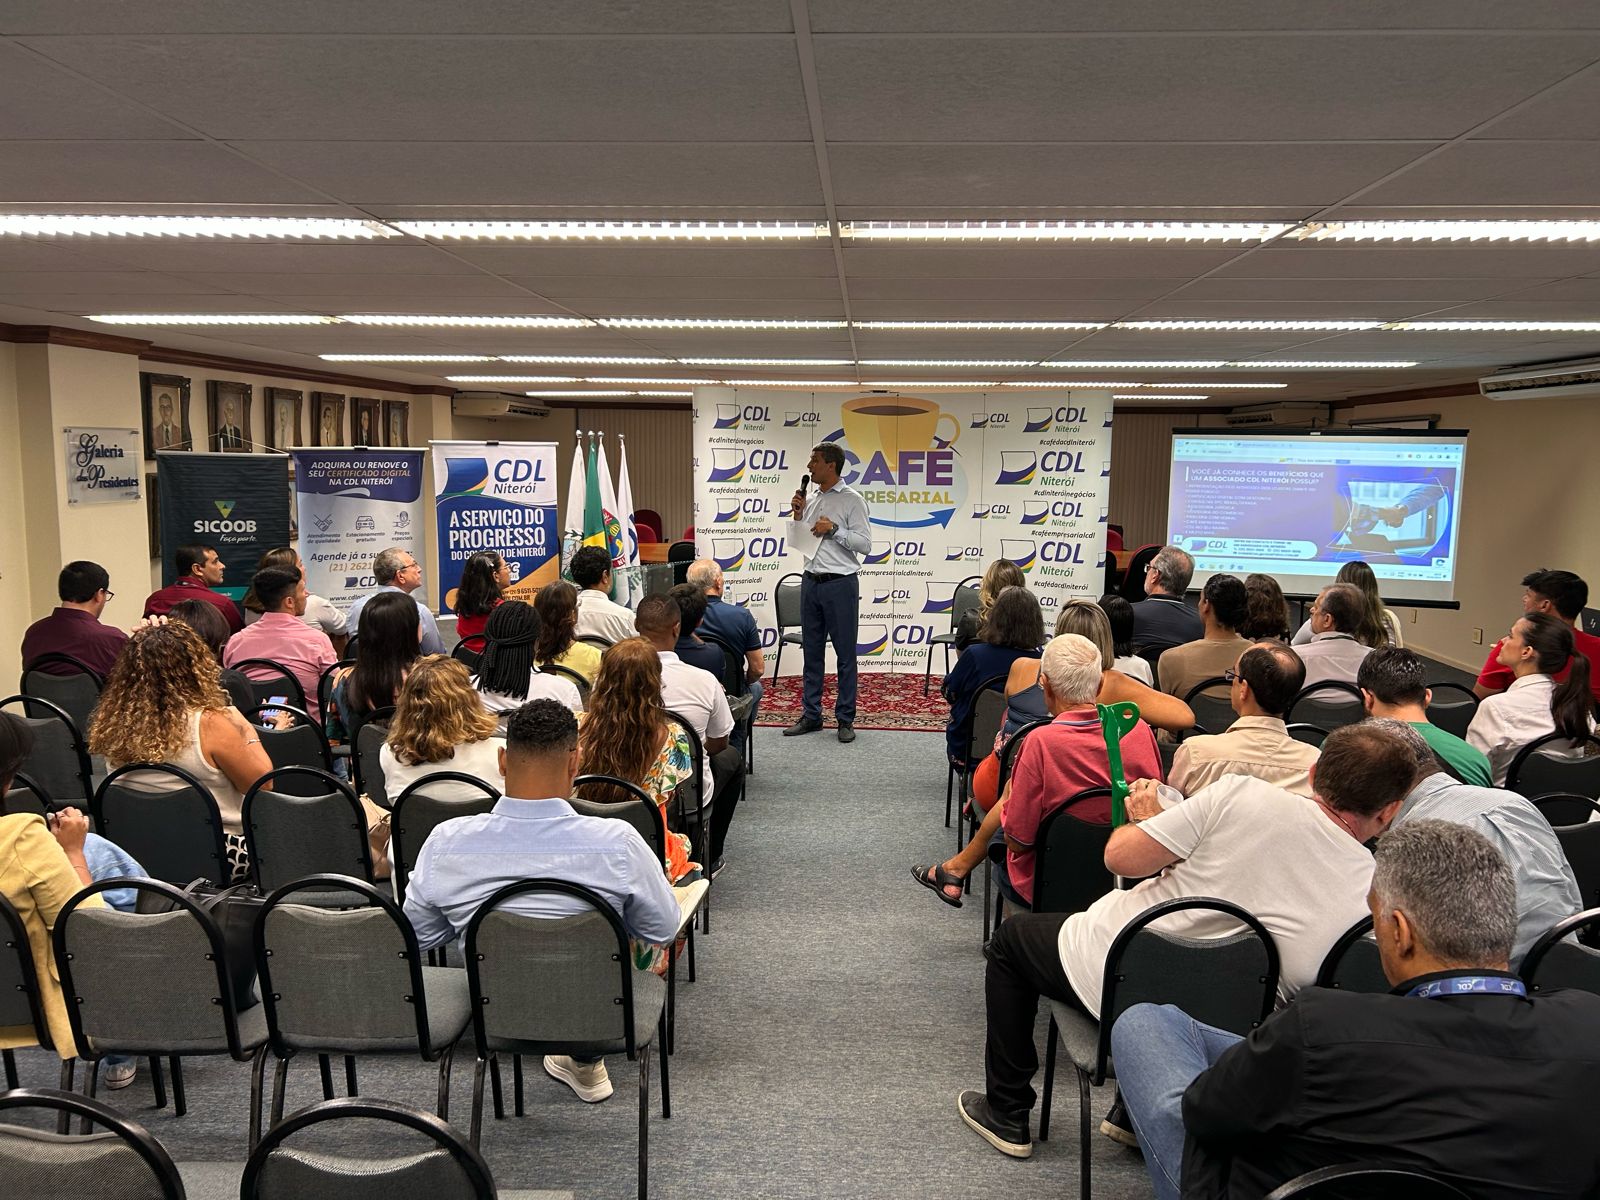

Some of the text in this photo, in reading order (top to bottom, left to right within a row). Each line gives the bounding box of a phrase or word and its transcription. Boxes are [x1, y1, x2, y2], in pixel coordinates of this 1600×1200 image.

[743, 405, 771, 421] CDL
[802, 412, 821, 422] CDL
[990, 413, 1010, 423] CDL
[1055, 407, 1088, 423] CDL
[743, 423, 766, 431] Niterói
[1055, 425, 1081, 433] Niterói
[708, 436, 765, 445] #cdlniteróinegócios
[76, 433, 124, 467] Galeria
[749, 449, 789, 470] CDL
[844, 441, 954, 486] CAFÉ
[1040, 450, 1086, 473] CDL
[311, 461, 351, 469] ADQUIRA
[308, 470, 325, 478] SEU
[327, 470, 379, 478] CERTIFICADO
[494, 459, 546, 482] CDL
[1268, 469, 1308, 478] BENEFÍCIOS
[87, 464, 139, 489] Presidentes
[329, 478, 342, 486] NA
[361, 477, 393, 485] NITERÓI
[749, 474, 781, 484] Niterói
[1040, 476, 1076, 487] Niterói
[1261, 476, 1289, 484] NITERÓI
[494, 482, 536, 494] Niterói
[742, 498, 771, 513] CDL
[991, 504, 1011, 514] CDL
[1051, 501, 1084, 518] CDL
[449, 508, 545, 528] A SERVIÇO DO
[1051, 519, 1077, 527] Niterói
[194, 520, 257, 533] SICOOB
[748, 537, 788, 558] CDL
[894, 541, 927, 556] CDL
[1208, 540, 1228, 549] CDL
[451, 550, 463, 560] DO
[506, 549, 516, 558] DE
[517, 546, 546, 557] NITERÓI
[964, 546, 984, 556] CDL
[1040, 541, 1084, 564] CDL
[310, 552, 347, 562] Agende
[348, 552, 358, 561] já
[894, 558, 920, 566] Niterói
[329, 563, 347, 572] (21)
[748, 561, 780, 571] Niterói
[1040, 565, 1075, 577] Niterói
[857, 569, 934, 577] aféempresarialcdlniterói
[360, 576, 378, 587] CD
[750, 592, 768, 602] CDL
[891, 589, 911, 599] CDL
[1040, 596, 1059, 607] CDL
[892, 624, 934, 645] CDL
[892, 647, 928, 657] Niterói
